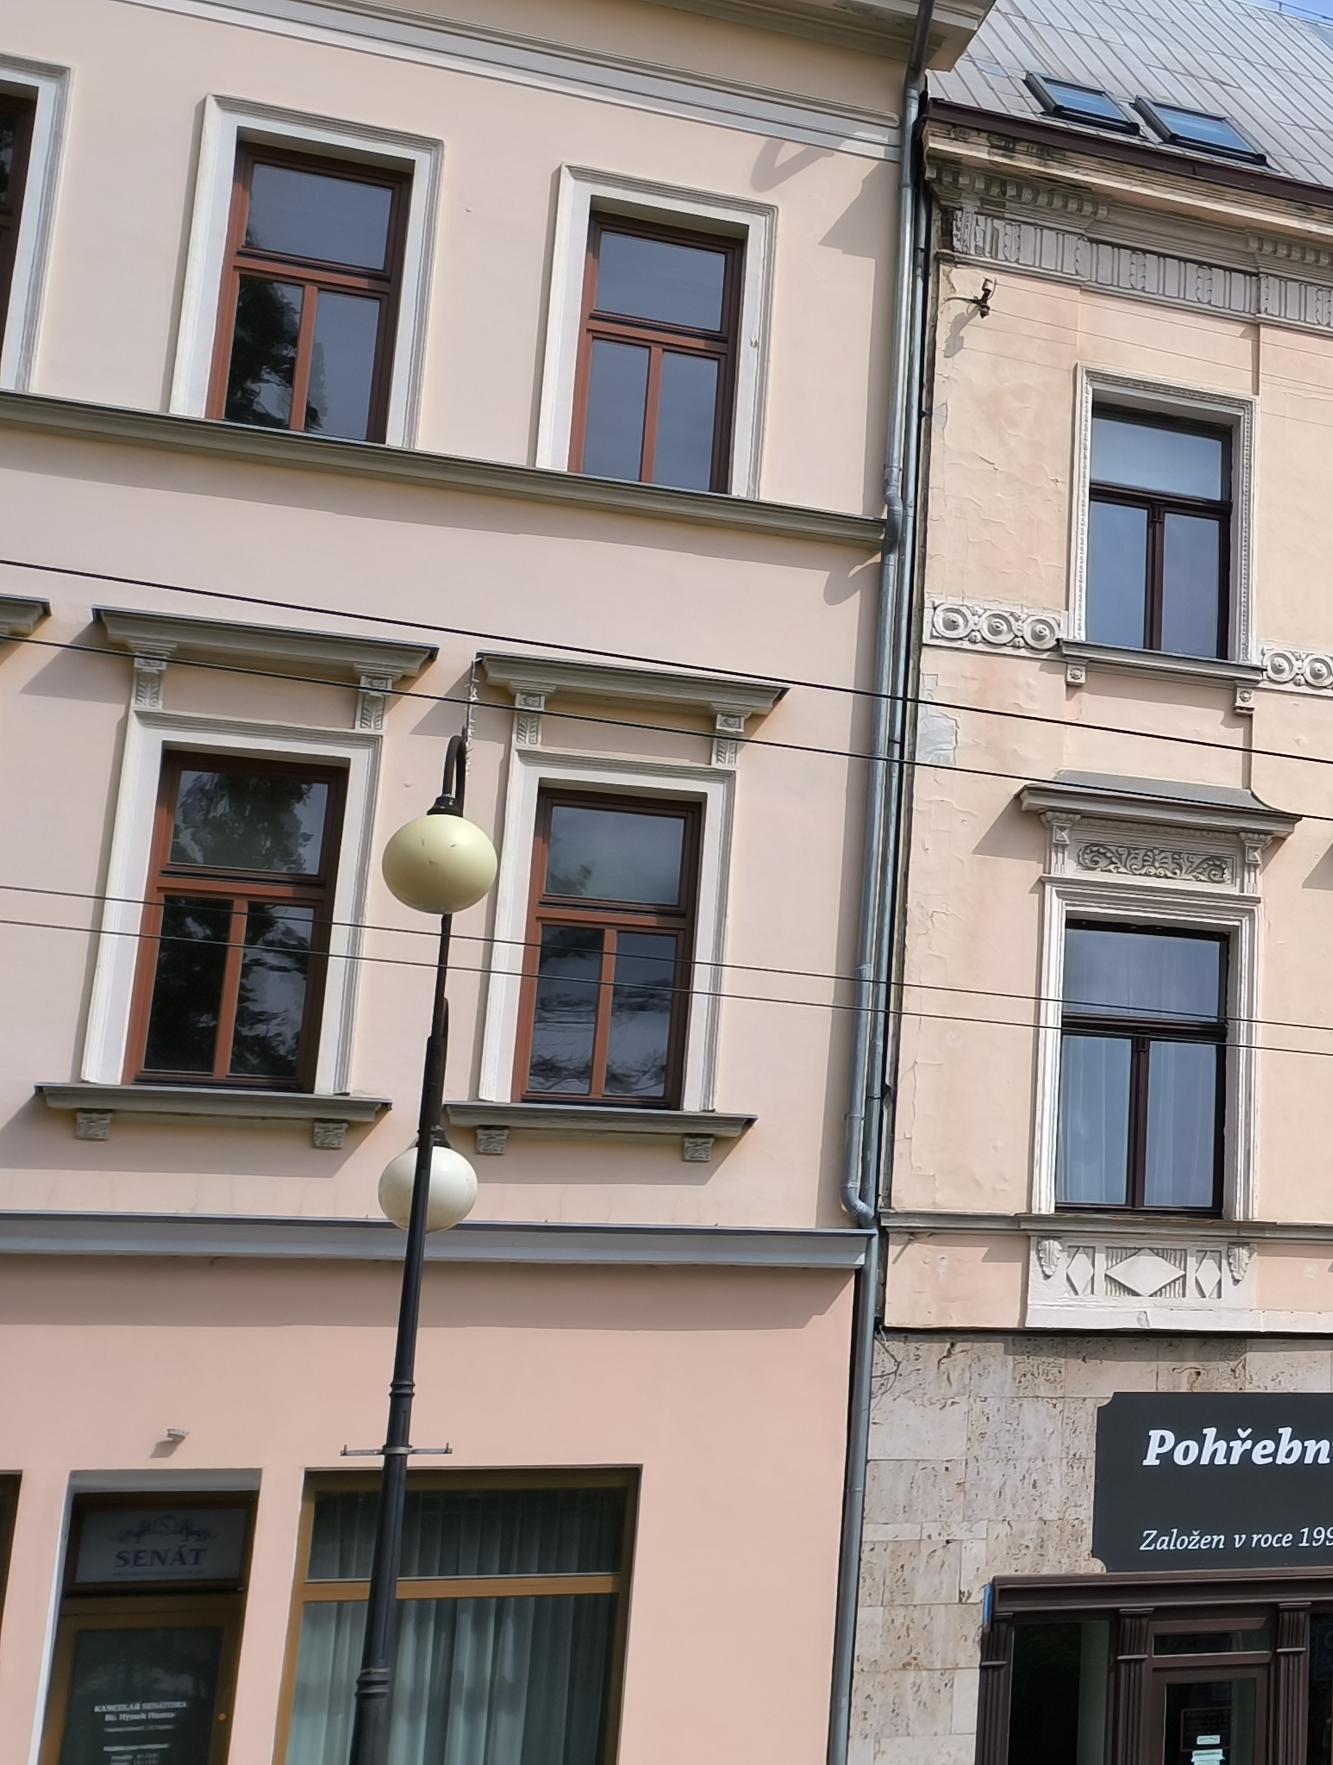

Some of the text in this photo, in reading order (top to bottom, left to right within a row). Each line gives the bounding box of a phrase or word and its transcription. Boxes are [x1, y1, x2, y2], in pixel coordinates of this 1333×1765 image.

[1139, 1529, 1225, 1551] Založen
[1233, 1534, 1247, 1548] v
[1251, 1533, 1293, 1548] roce
[114, 1544, 207, 1568] SENÁT
